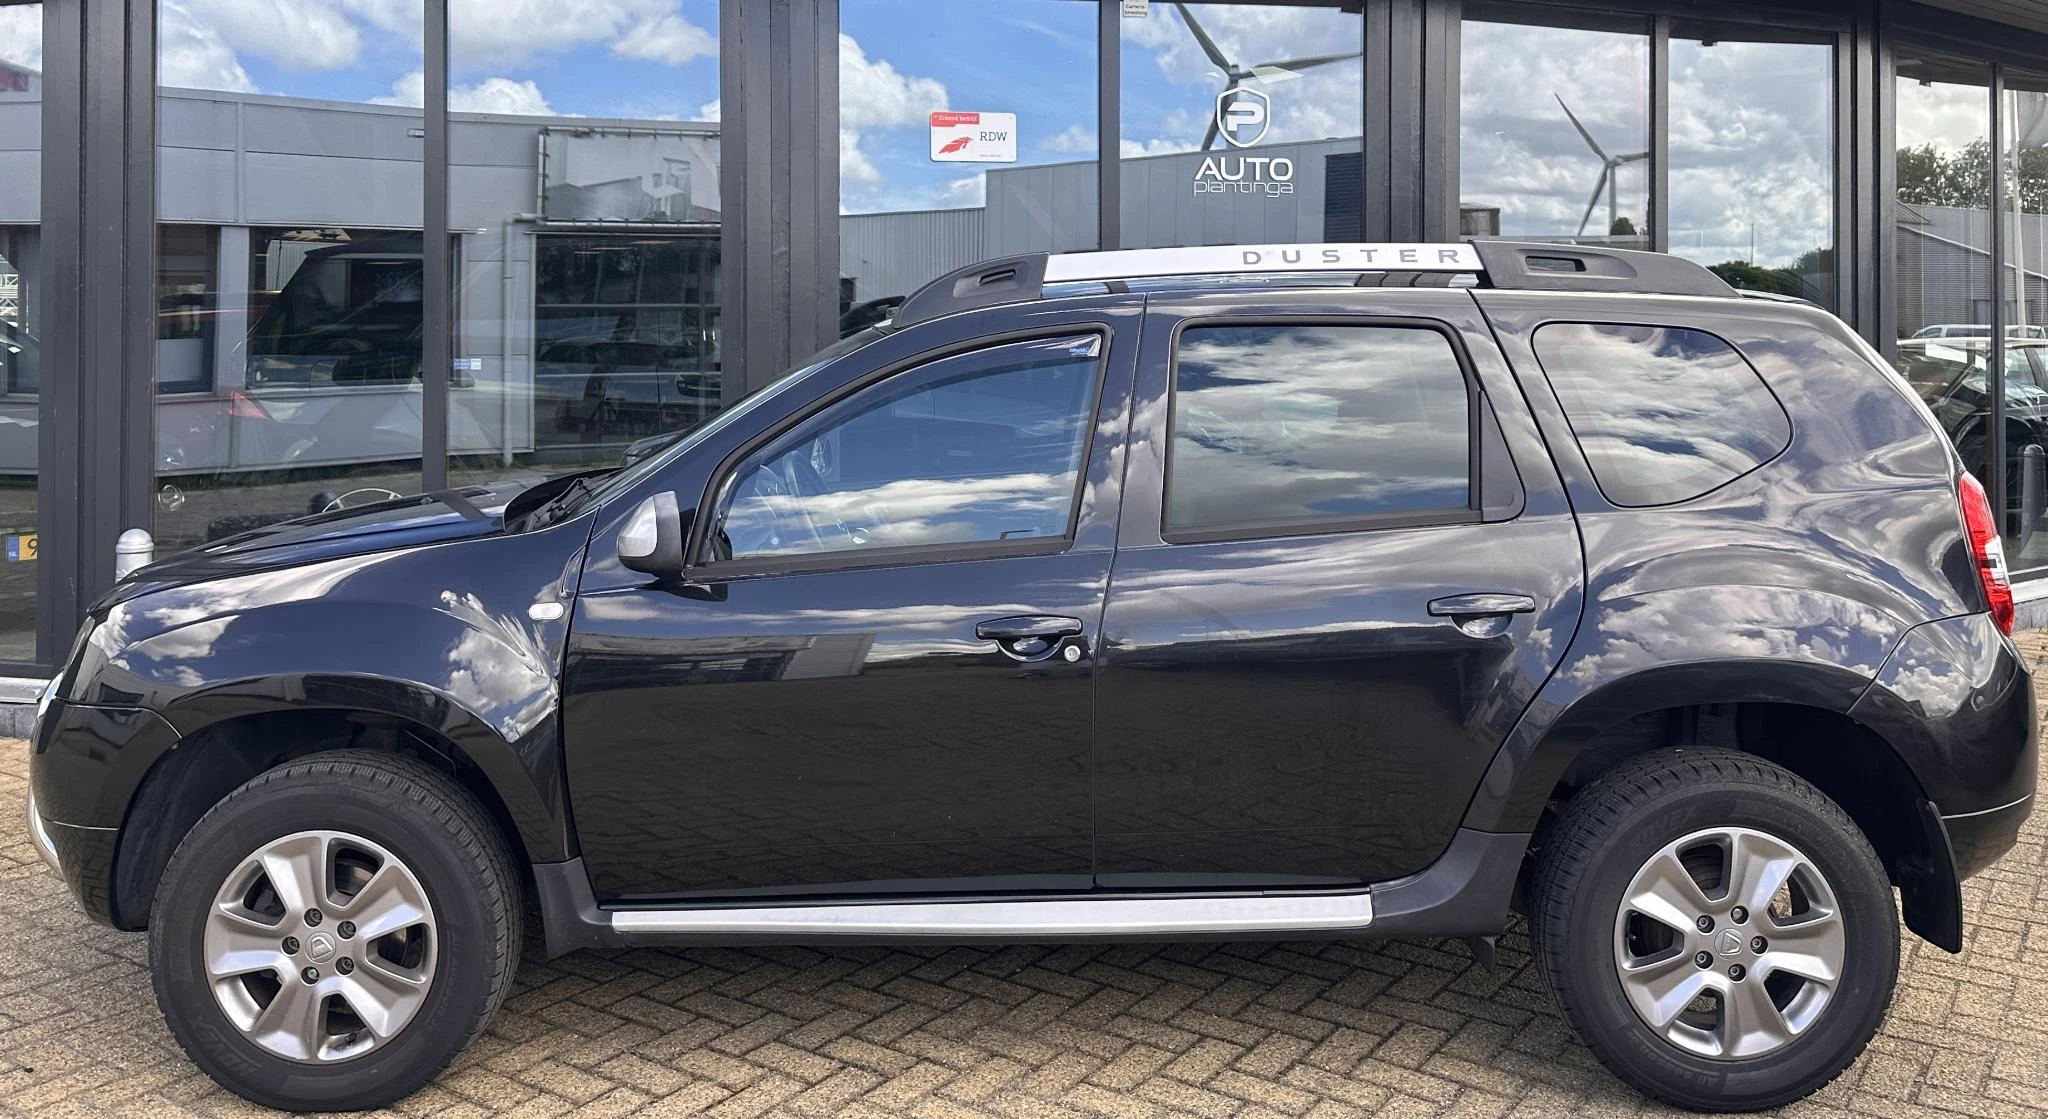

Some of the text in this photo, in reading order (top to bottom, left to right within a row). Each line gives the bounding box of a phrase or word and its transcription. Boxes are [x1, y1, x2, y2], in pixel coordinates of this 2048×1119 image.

[1226, 101, 1265, 131] P
[979, 132, 1007, 141] RDW
[1194, 156, 1294, 181] AUTO
[1193, 178, 1294, 198] plantinga
[1242, 248, 1460, 265] DUSTER
